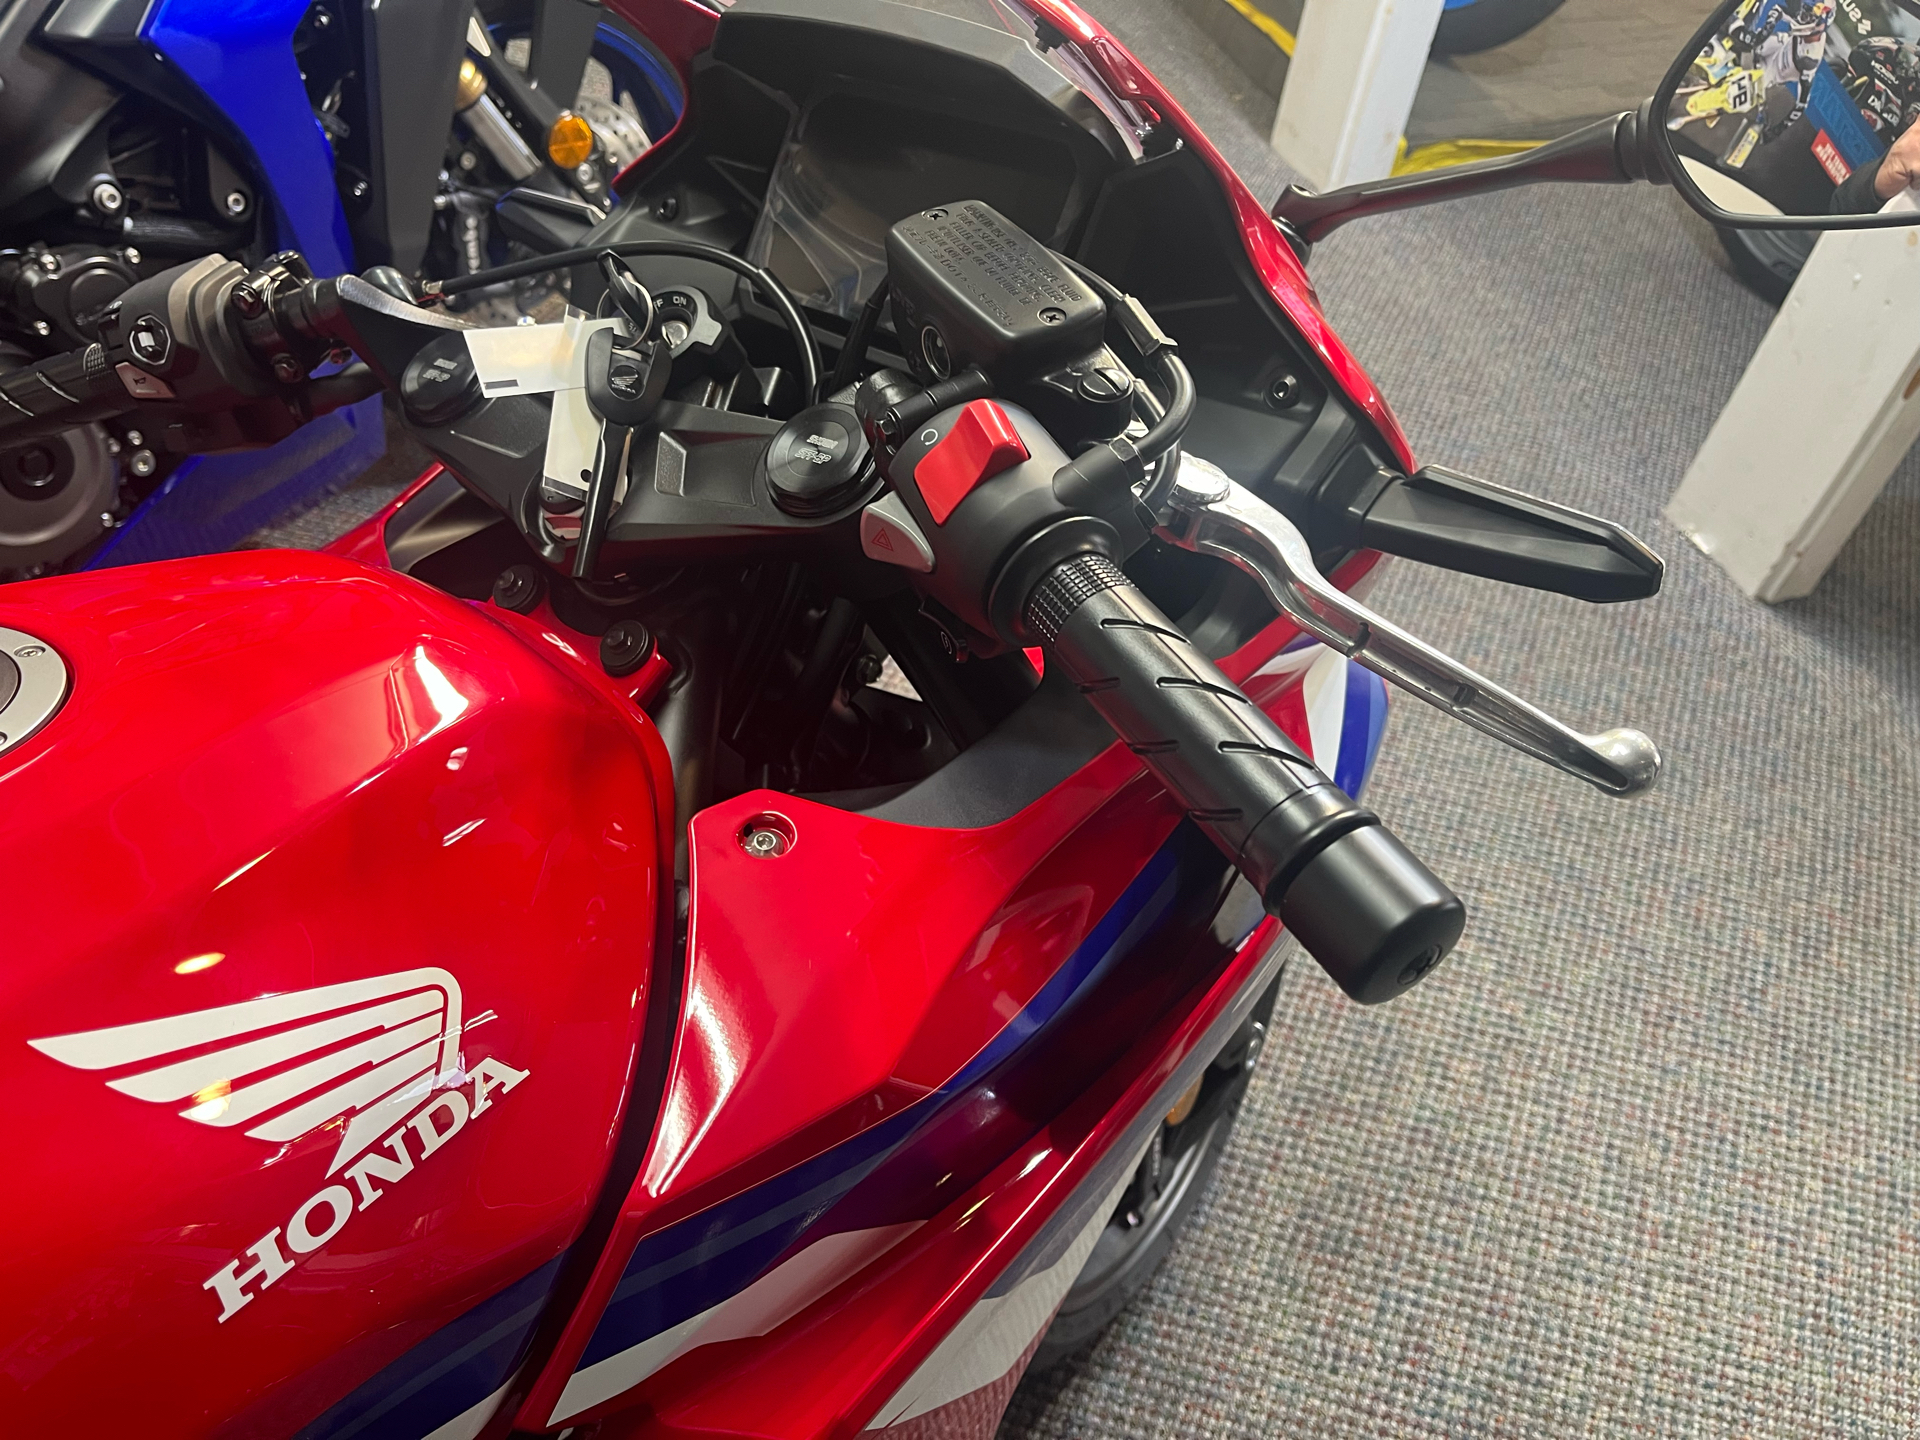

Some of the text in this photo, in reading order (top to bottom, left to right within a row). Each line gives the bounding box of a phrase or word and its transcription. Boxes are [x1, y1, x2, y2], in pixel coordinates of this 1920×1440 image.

[947, 220, 976, 241] FILLER
[672, 296, 687, 306] ON
[1055, 282, 1084, 303] FLUID
[203, 1056, 531, 1324] HONDA
